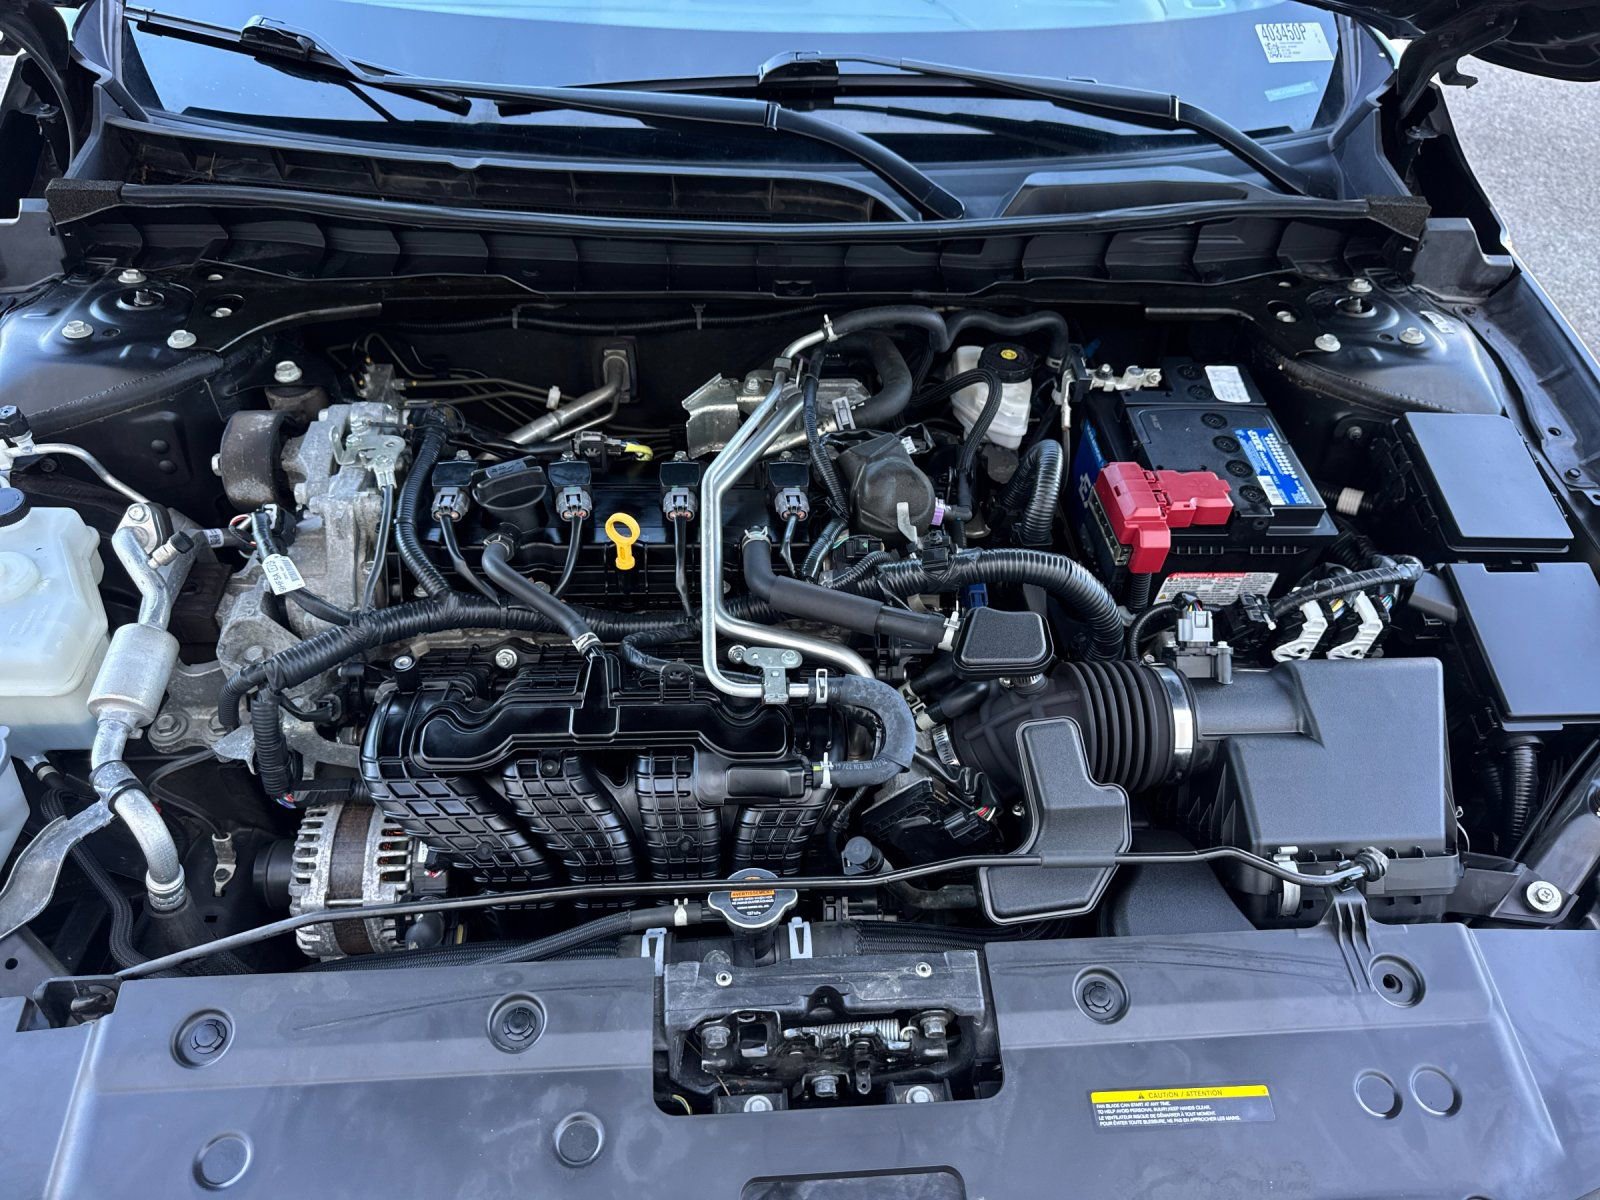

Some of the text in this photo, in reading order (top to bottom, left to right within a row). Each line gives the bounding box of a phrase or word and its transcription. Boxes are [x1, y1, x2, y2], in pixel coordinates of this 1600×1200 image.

[1261, 24, 1306, 41] 403450P
[1148, 1091, 1179, 1099] CAUTION
[1186, 1089, 1223, 1097] ATTENTION
